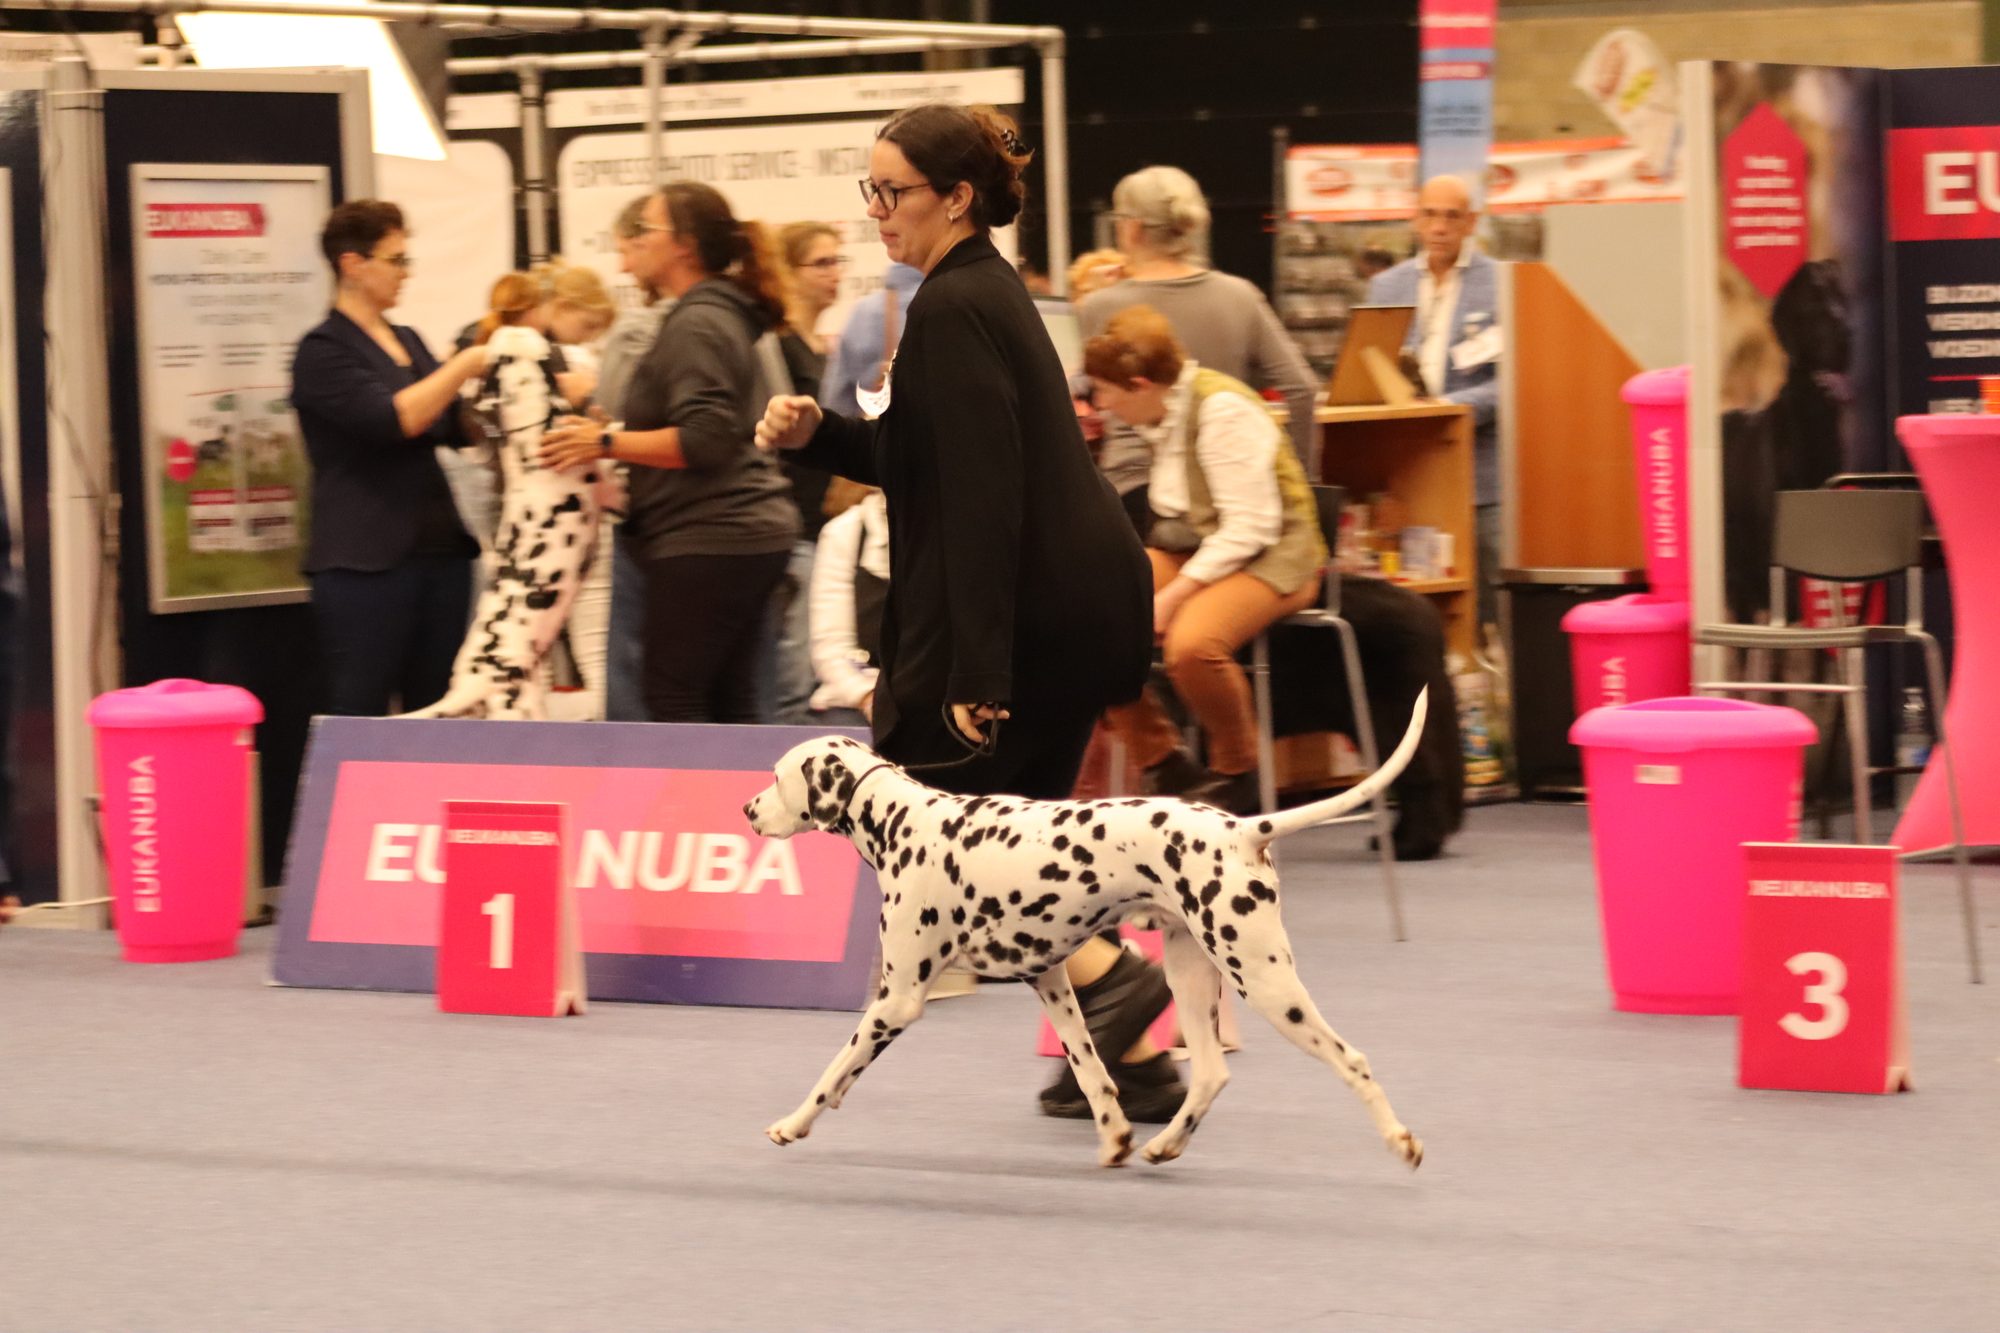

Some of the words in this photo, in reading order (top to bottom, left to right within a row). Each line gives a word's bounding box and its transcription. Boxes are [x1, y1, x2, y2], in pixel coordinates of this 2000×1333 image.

[574, 160, 650, 188] EXPRESS
[1648, 426, 1679, 558] EUKANUBA
[128, 755, 162, 912] EUKANUBA
[480, 893, 517, 970] 1
[1777, 951, 1850, 1041] 3
